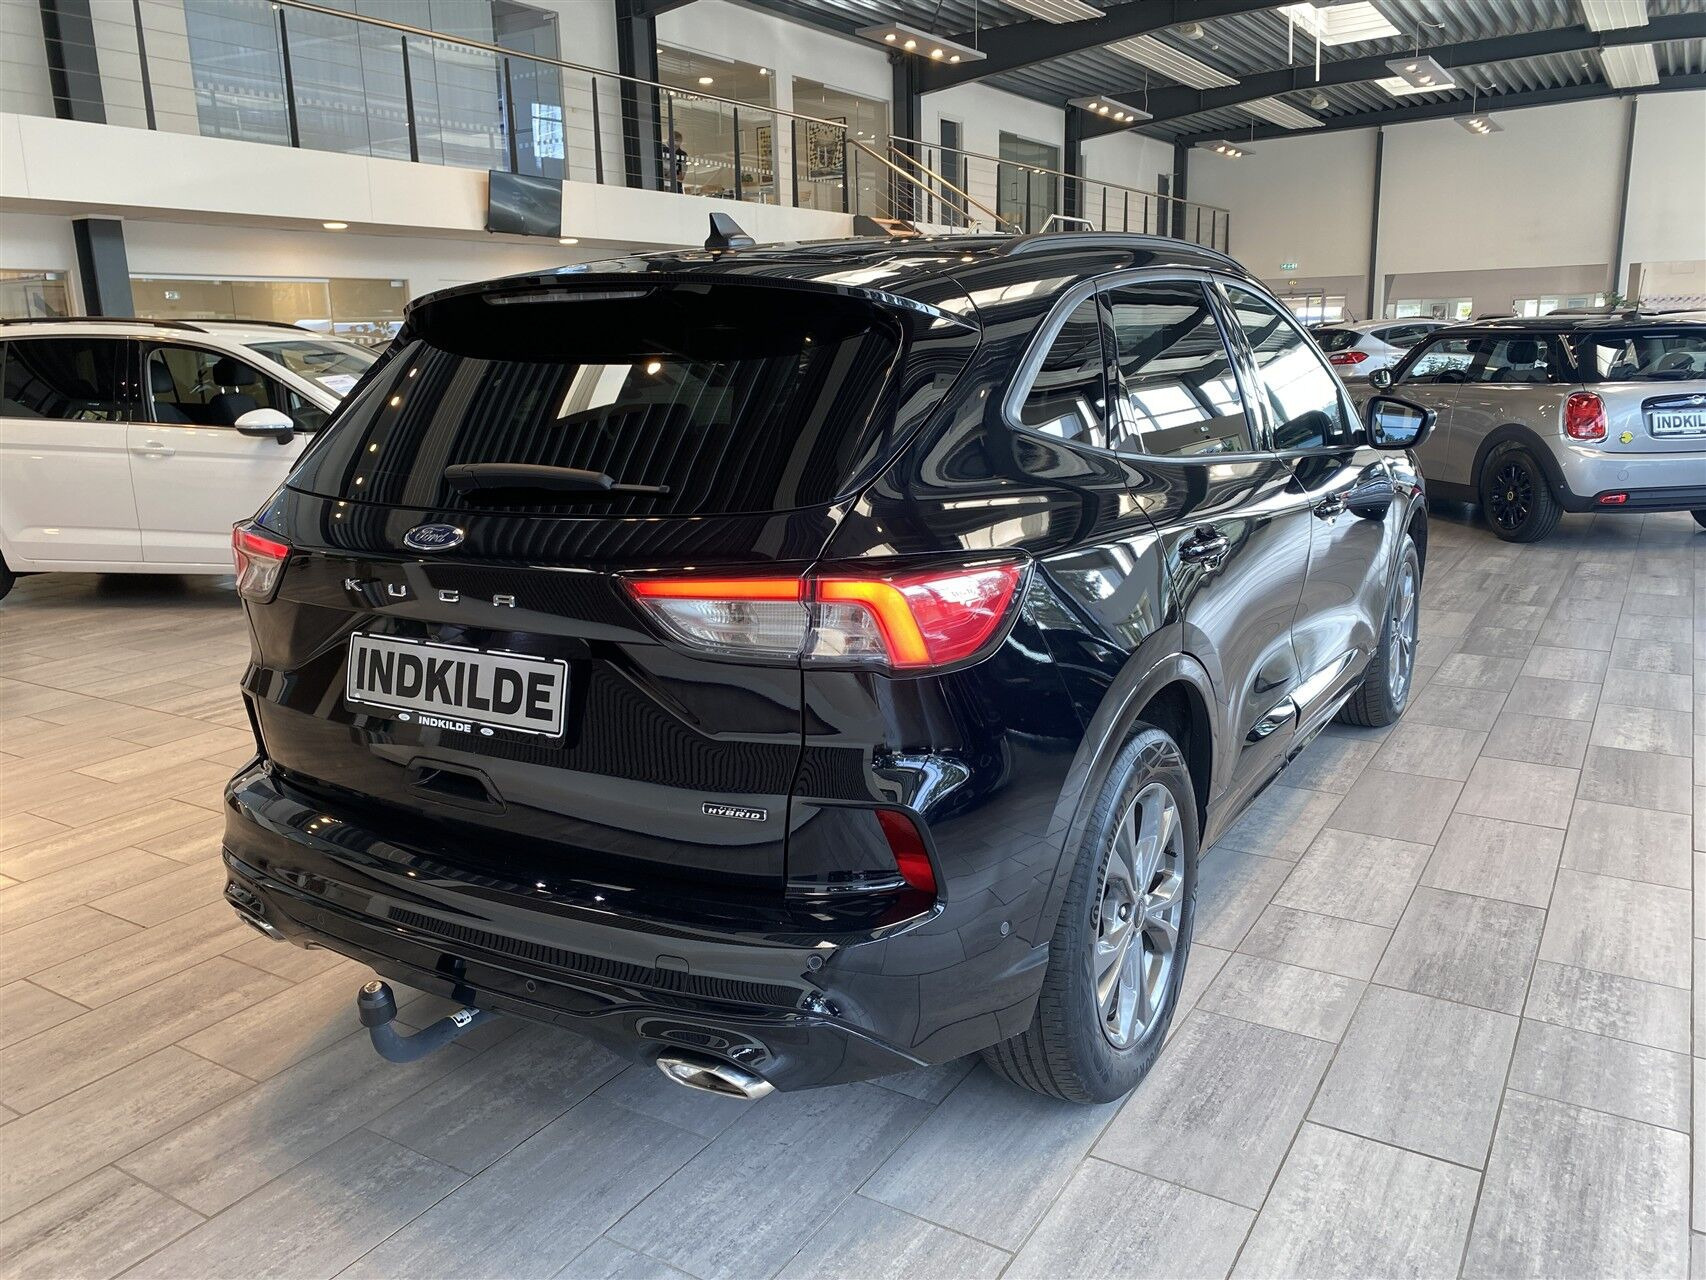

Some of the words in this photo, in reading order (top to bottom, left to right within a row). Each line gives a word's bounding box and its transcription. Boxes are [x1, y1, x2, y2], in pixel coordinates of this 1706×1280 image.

[344, 578, 516, 608] KUGA
[356, 647, 555, 722] INDKILDE
[418, 715, 472, 733] INDKILDE
[708, 807, 761, 819] HYBRID
